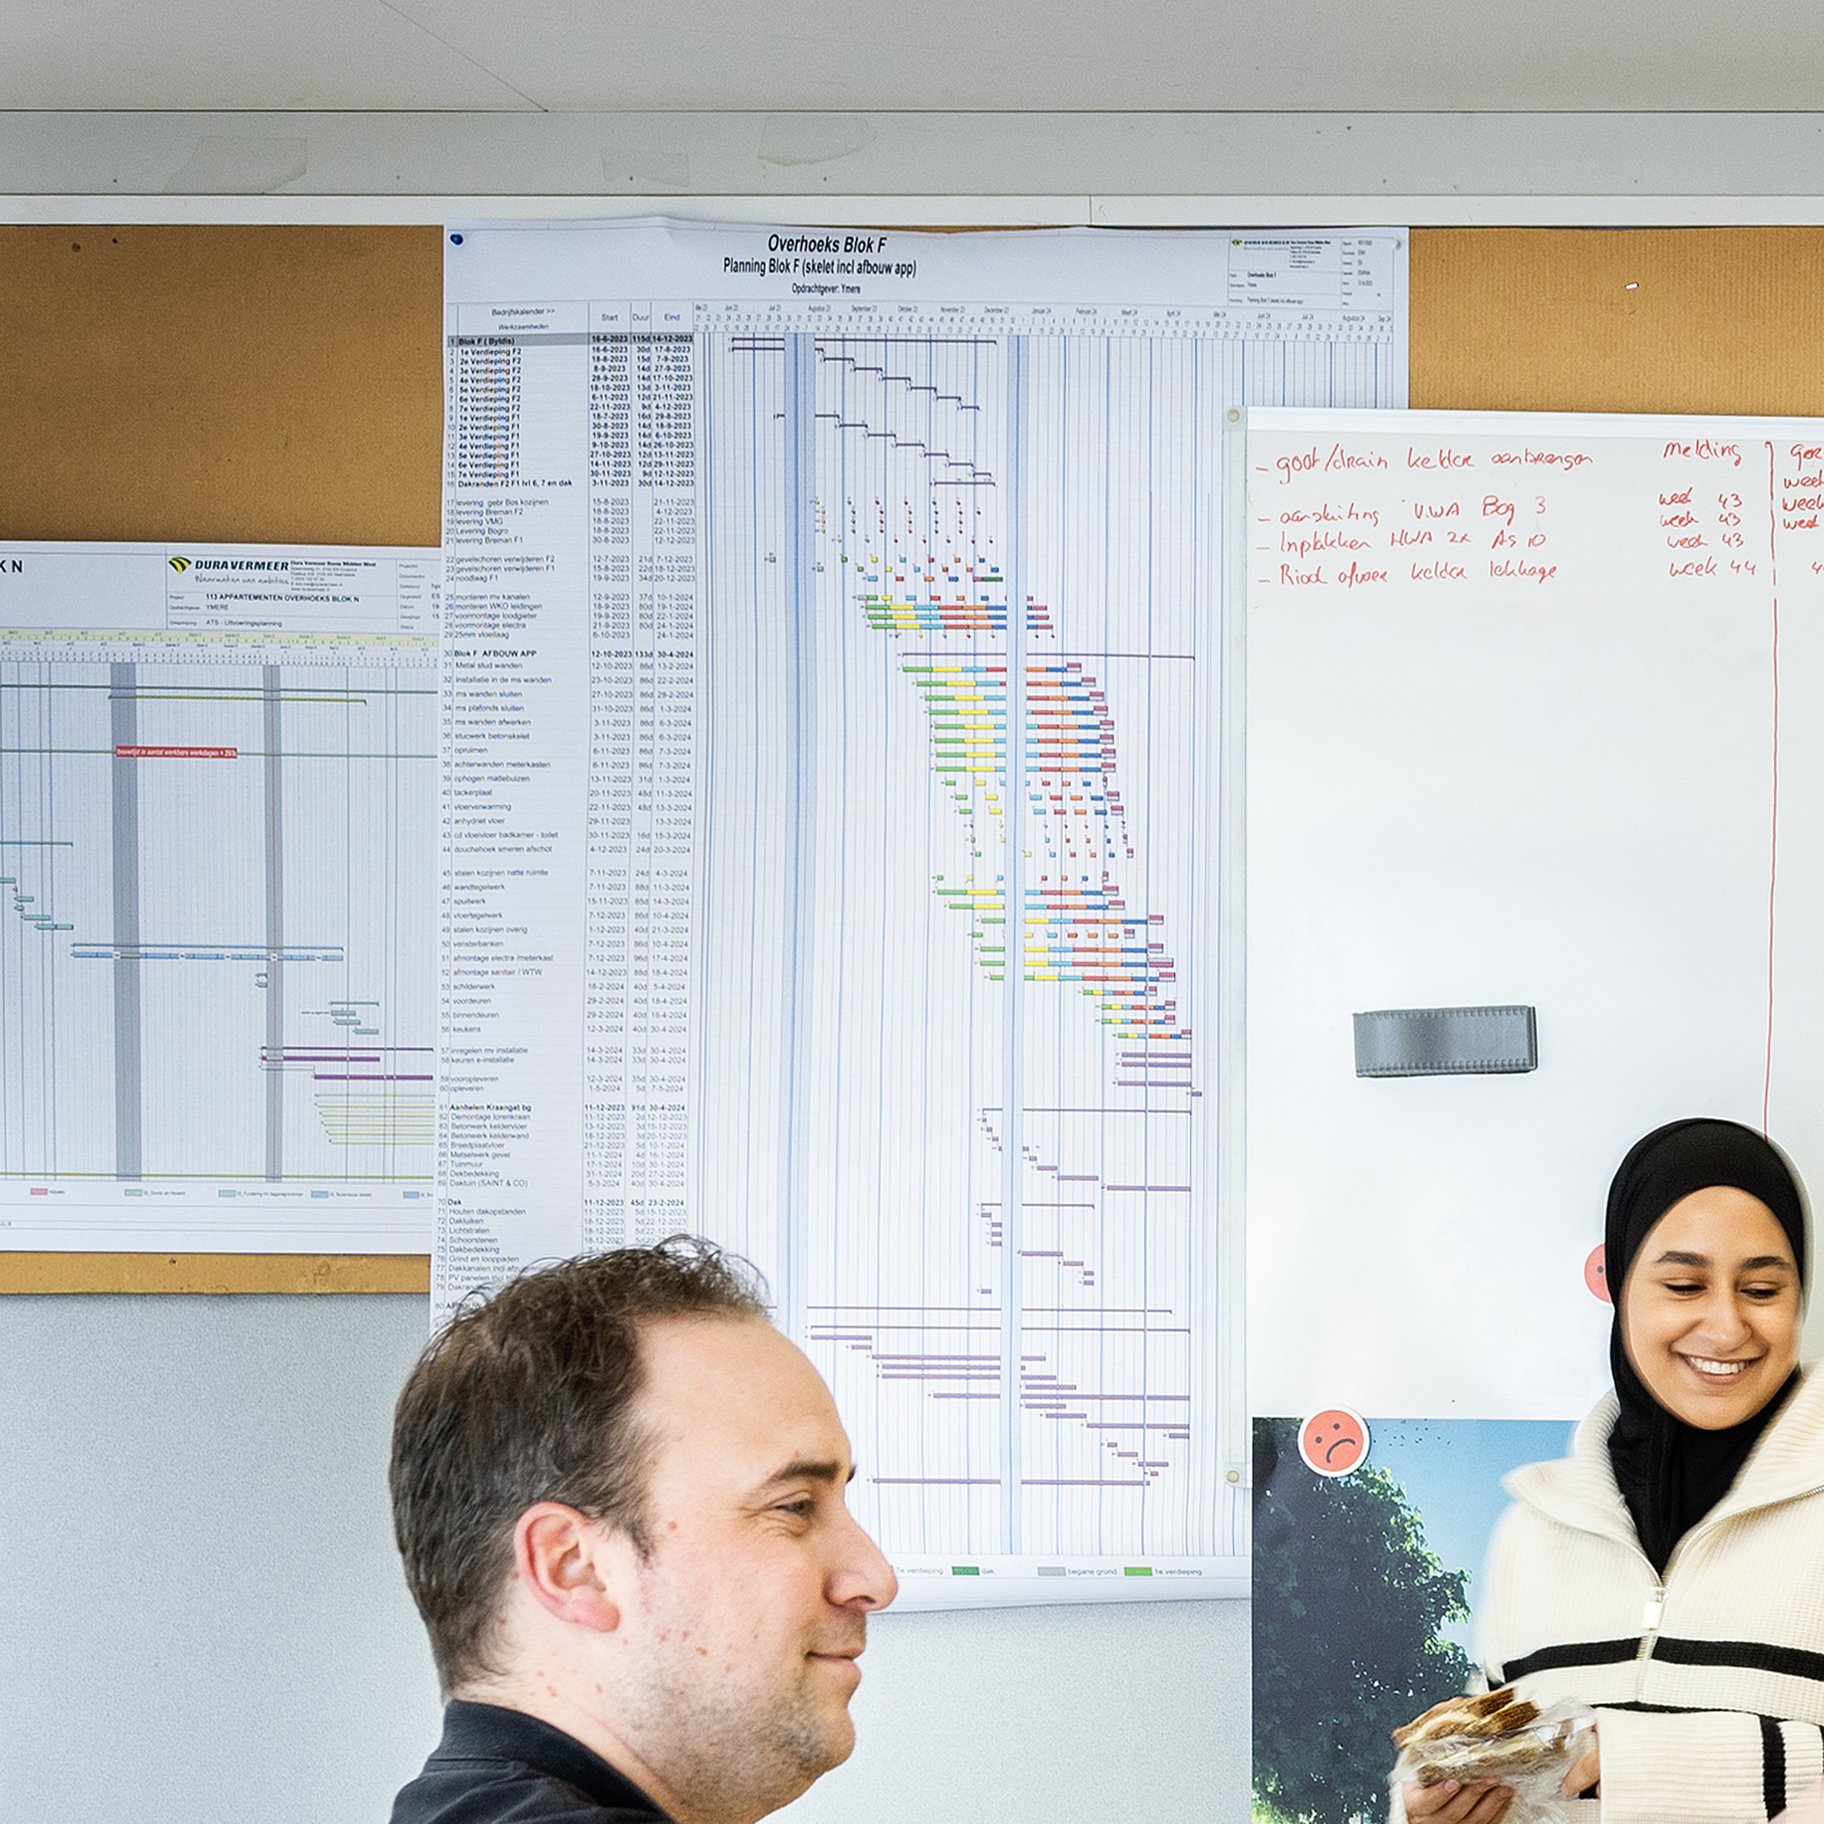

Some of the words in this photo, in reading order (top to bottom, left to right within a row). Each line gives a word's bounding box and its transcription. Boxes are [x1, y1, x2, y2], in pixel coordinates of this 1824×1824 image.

[768, 233, 840, 253] Overhoeks
[844, 236, 874, 253] Blok
[877, 237, 887, 253] F
[724, 257, 766, 276] Planning
[769, 258, 790, 273] Blok
[793, 258, 800, 273] F
[802, 259, 834, 276] (skelet
[837, 260, 854, 274] incl
[856, 260, 893, 274] afbouw
[895, 260, 917, 278] app)
[841, 284, 861, 294] Ymere
[1718, 494, 1742, 509] 43
[1718, 513, 1740, 526] 43
[1722, 533, 1744, 548] 43
[12, 560, 22, 572] N
